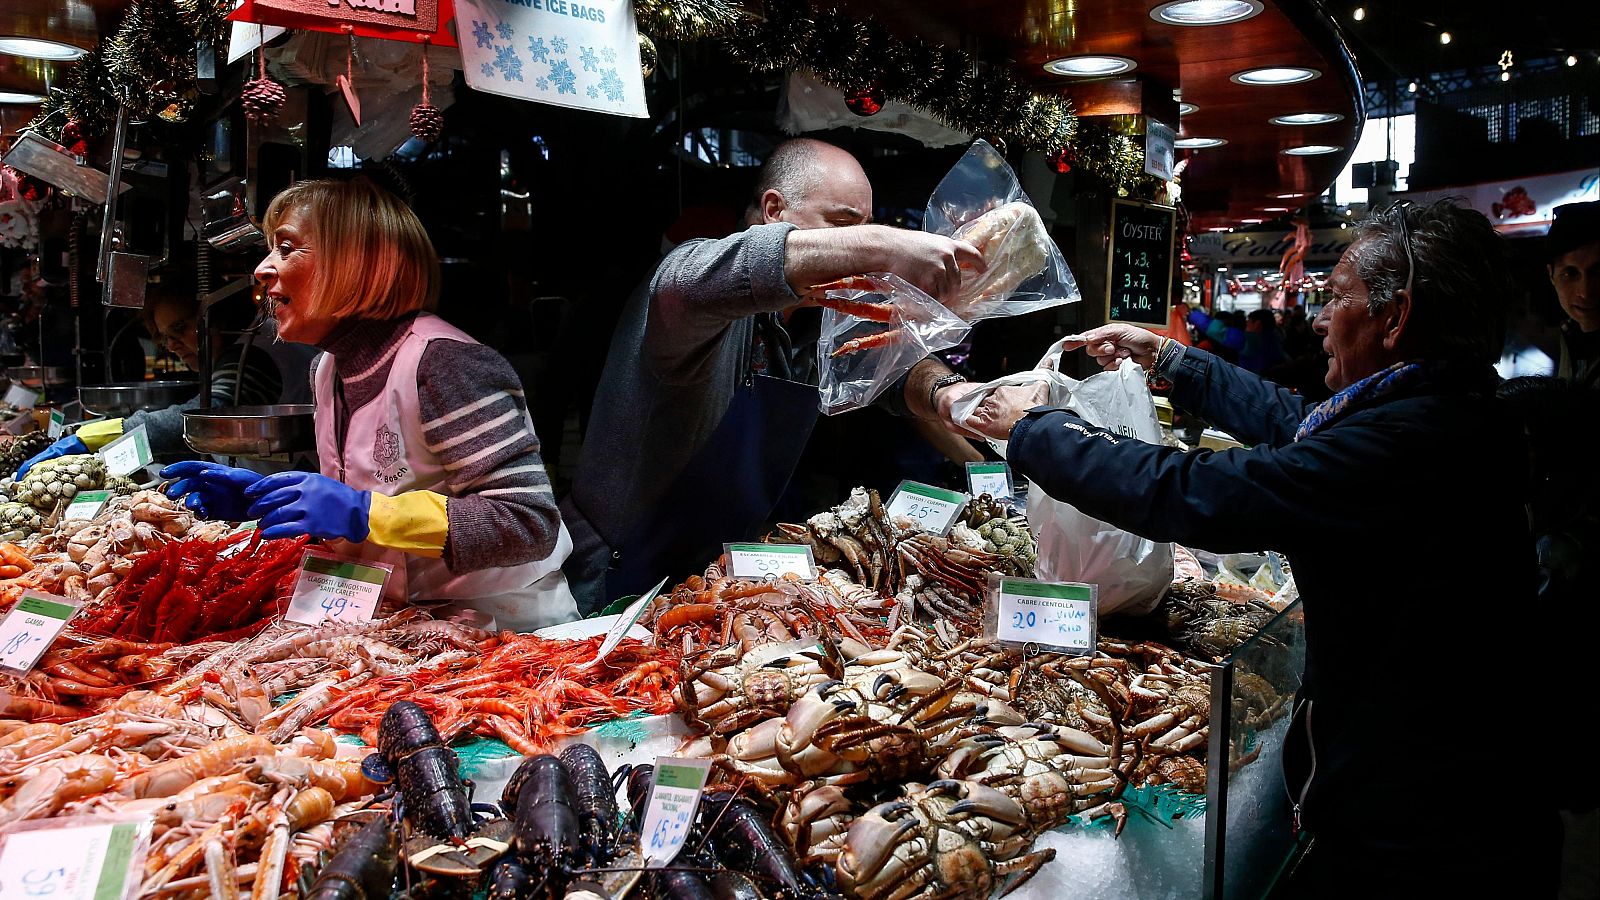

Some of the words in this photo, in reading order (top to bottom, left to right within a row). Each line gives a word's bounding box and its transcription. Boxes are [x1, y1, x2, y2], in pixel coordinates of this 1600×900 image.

[546, 0, 568, 16] ICE
[571, 3, 605, 23] BAGS
[1123, 222, 1162, 241] OYSTER
[1124, 251, 1131, 265] 1
[1124, 273, 1131, 288] 3
[1123, 294, 1130, 309] 4
[374, 470, 383, 481] M.
[384, 467, 408, 484] Bosch
[307, 576, 334, 587] LLAGOSTI
[337, 581, 373, 594] LANGOSTINO
[1017, 598, 1037, 606] CABRE
[1042, 600, 1074, 609] CENTOLLA
